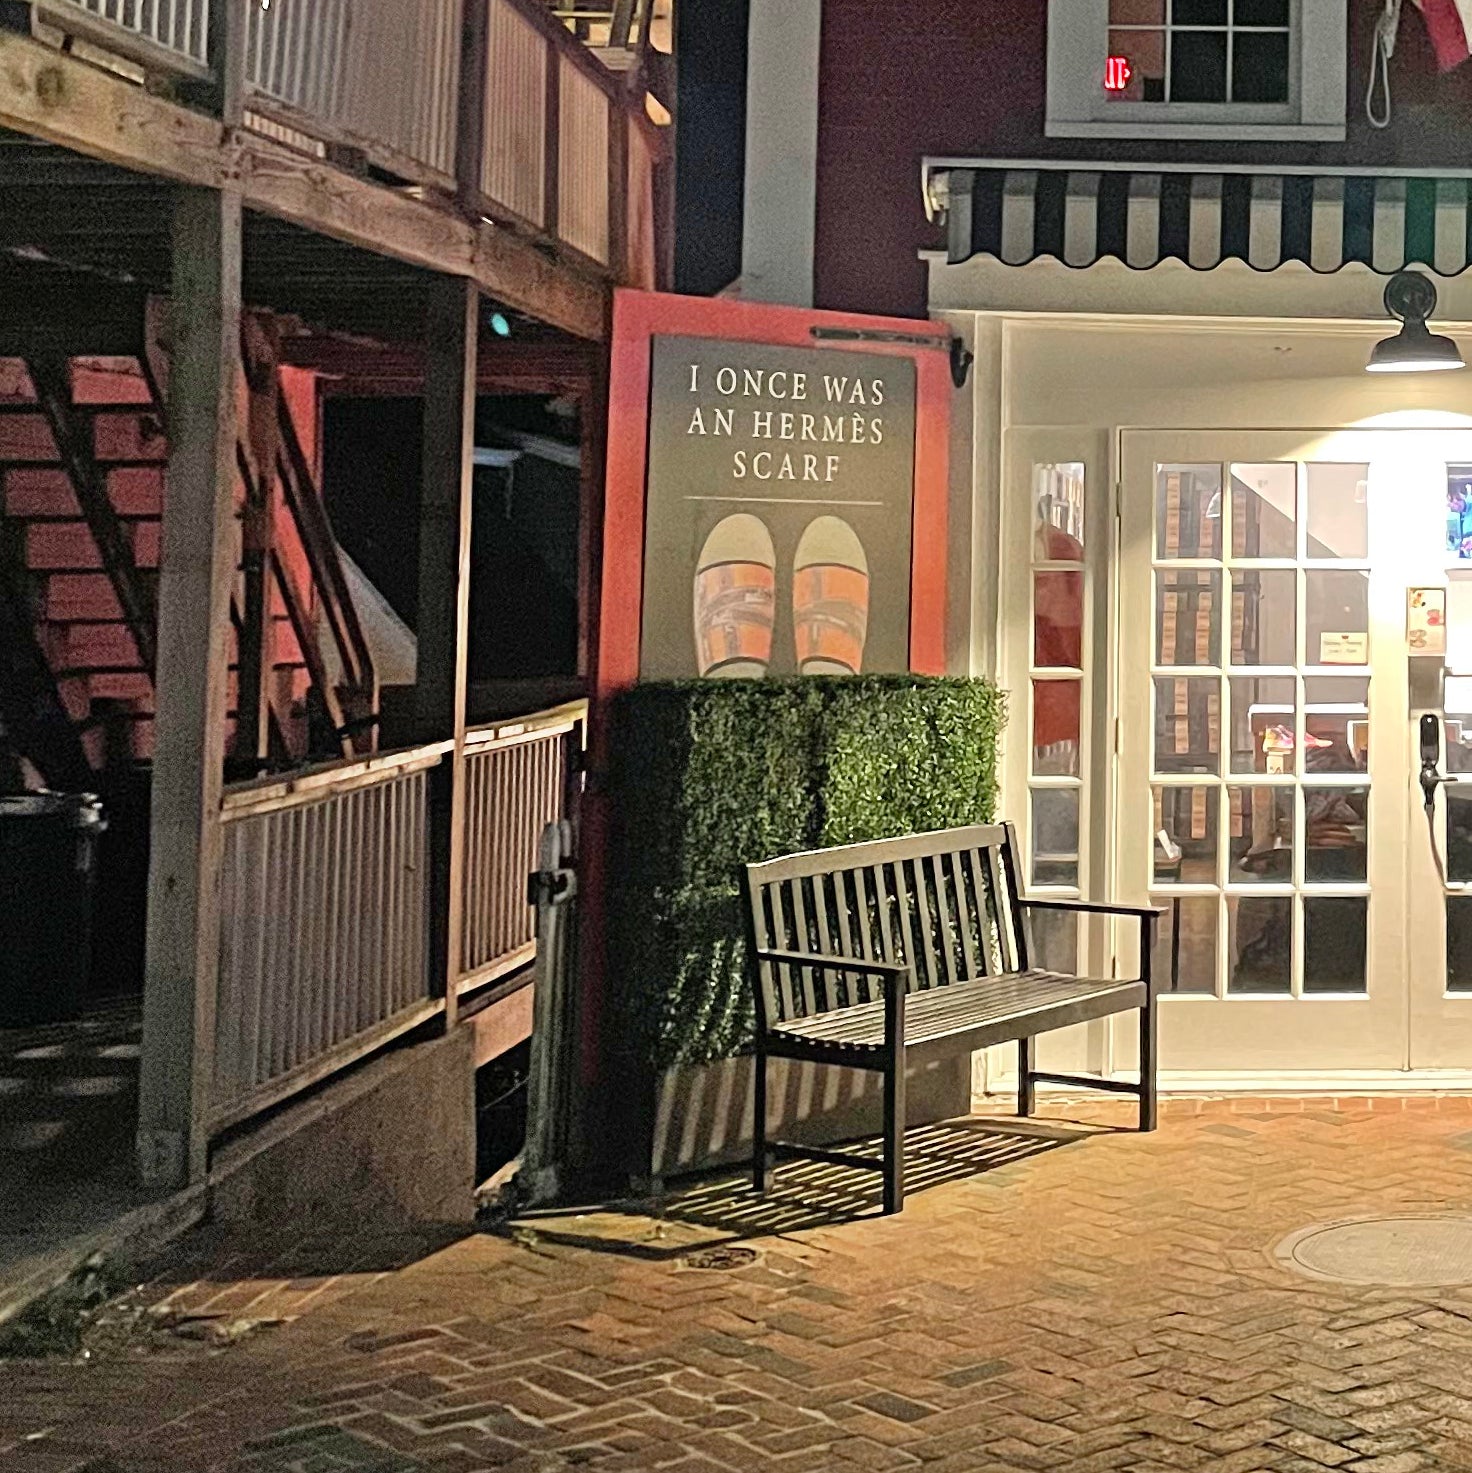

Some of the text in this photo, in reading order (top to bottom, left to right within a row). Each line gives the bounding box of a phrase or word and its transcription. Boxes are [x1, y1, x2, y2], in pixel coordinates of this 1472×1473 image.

[689, 365, 884, 406] I ONCE WAS
[687, 407, 884, 445] AN HERMÈS
[733, 450, 840, 482] SCARF
